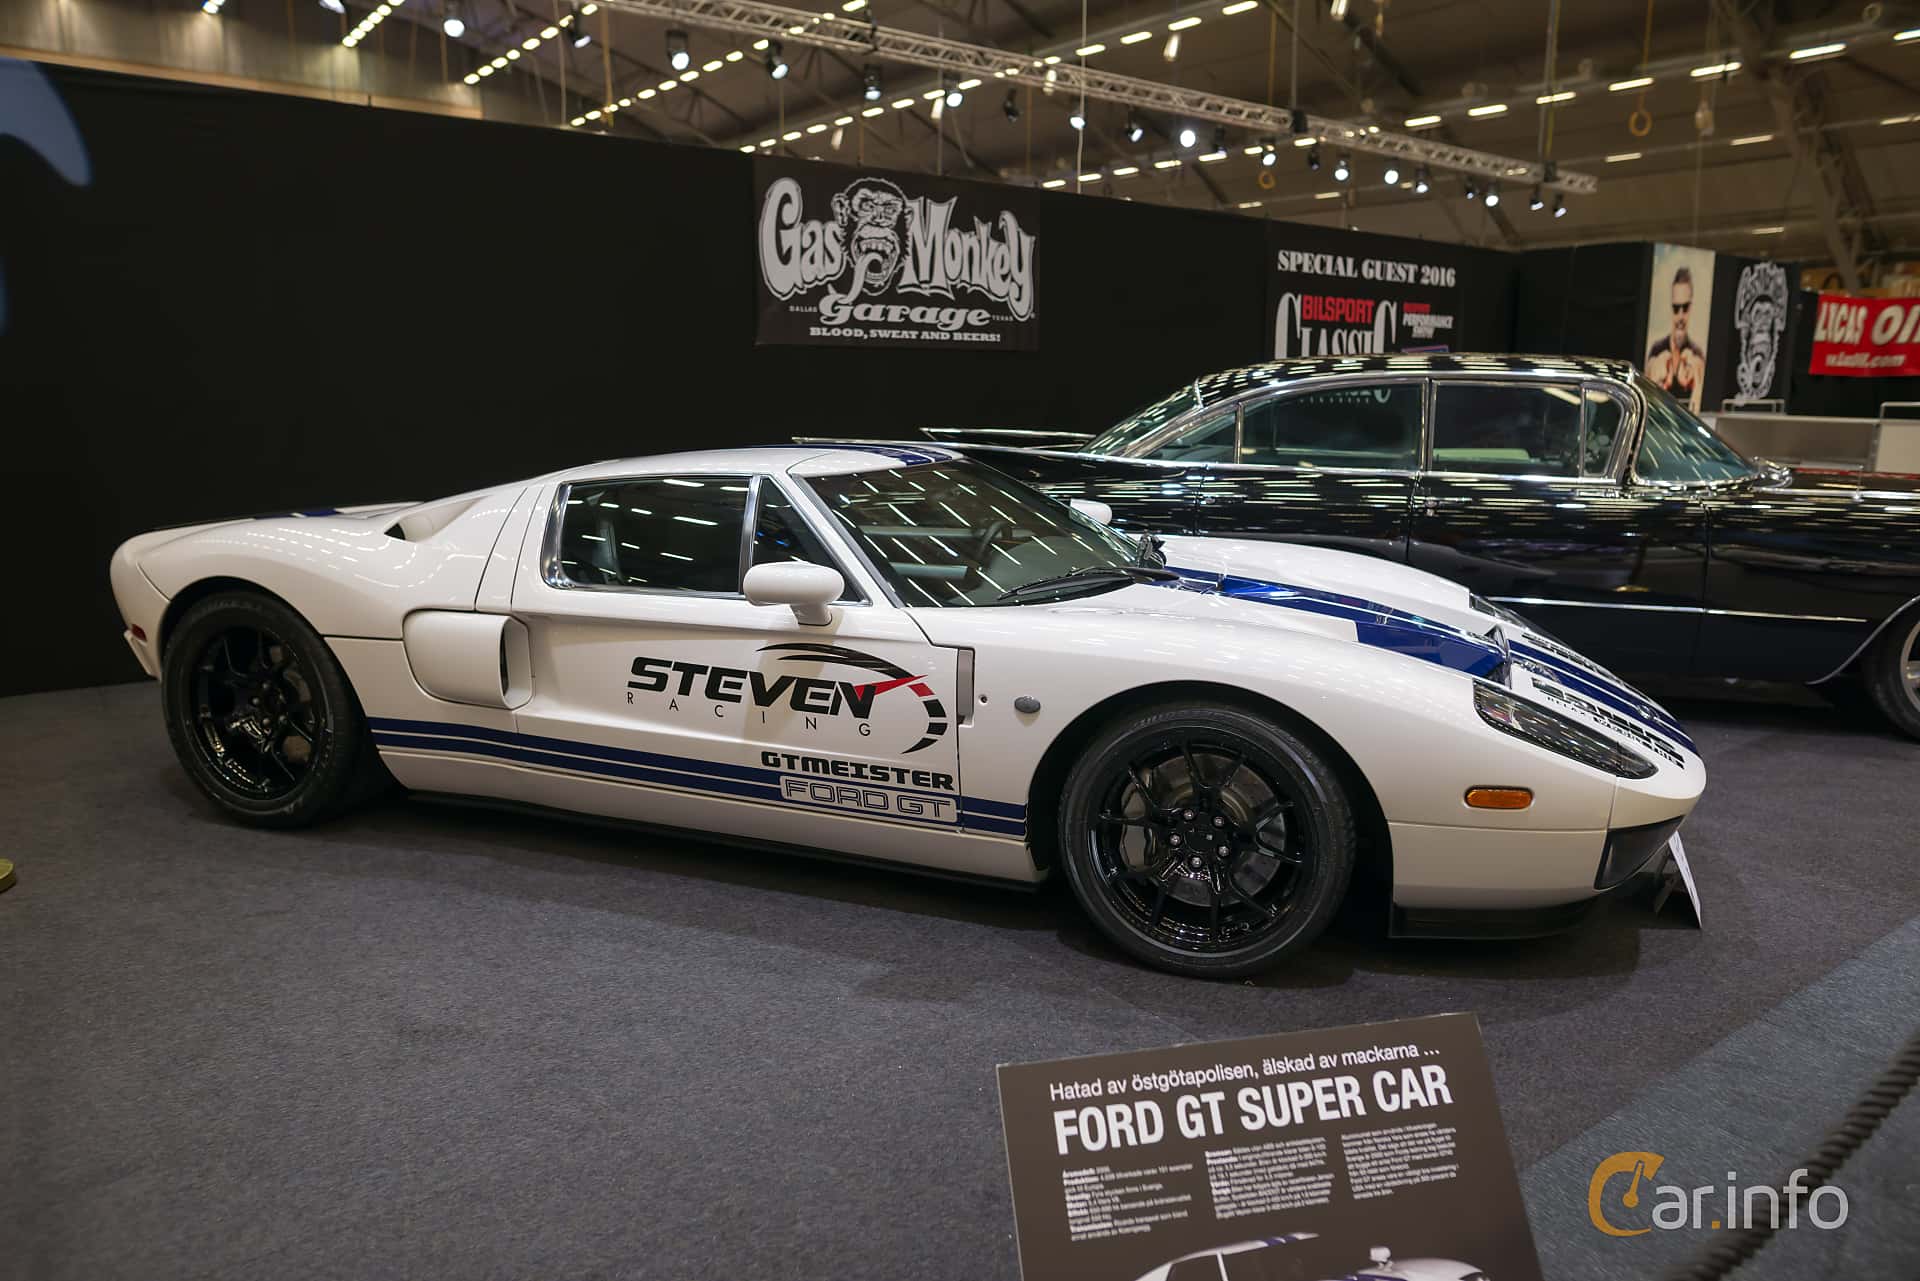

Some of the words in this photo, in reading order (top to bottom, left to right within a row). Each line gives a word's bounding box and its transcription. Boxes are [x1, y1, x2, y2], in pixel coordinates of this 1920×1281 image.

[759, 177, 846, 300] Gas
[896, 196, 1035, 321] Monkey
[1277, 249, 1358, 278] SPECIAL
[1362, 259, 1417, 284] GUEST
[1420, 265, 1456, 287] 2016
[1302, 294, 1375, 325] BILSPORT
[809, 327, 868, 339] BLOOD,
[869, 329, 919, 339] SWEAT
[921, 331, 950, 340] AND
[627, 656, 877, 720] STEVEN
[761, 751, 954, 791] GTMEISTER
[784, 777, 888, 811] FORD
[897, 794, 951, 818] GT
[1050, 1078, 1103, 1102] Hatad
[1107, 1079, 1128, 1095] av
[1132, 1063, 1259, 1092] östgötapolisen,
[1263, 1053, 1316, 1076] älskad
[1319, 1053, 1338, 1069] av
[1342, 1044, 1419, 1066] mackarna
[1054, 1100, 1165, 1155] FORD
[1177, 1091, 1226, 1139] GT
[1237, 1075, 1367, 1131] SUPER
[1372, 1064, 1454, 1113] CAR
